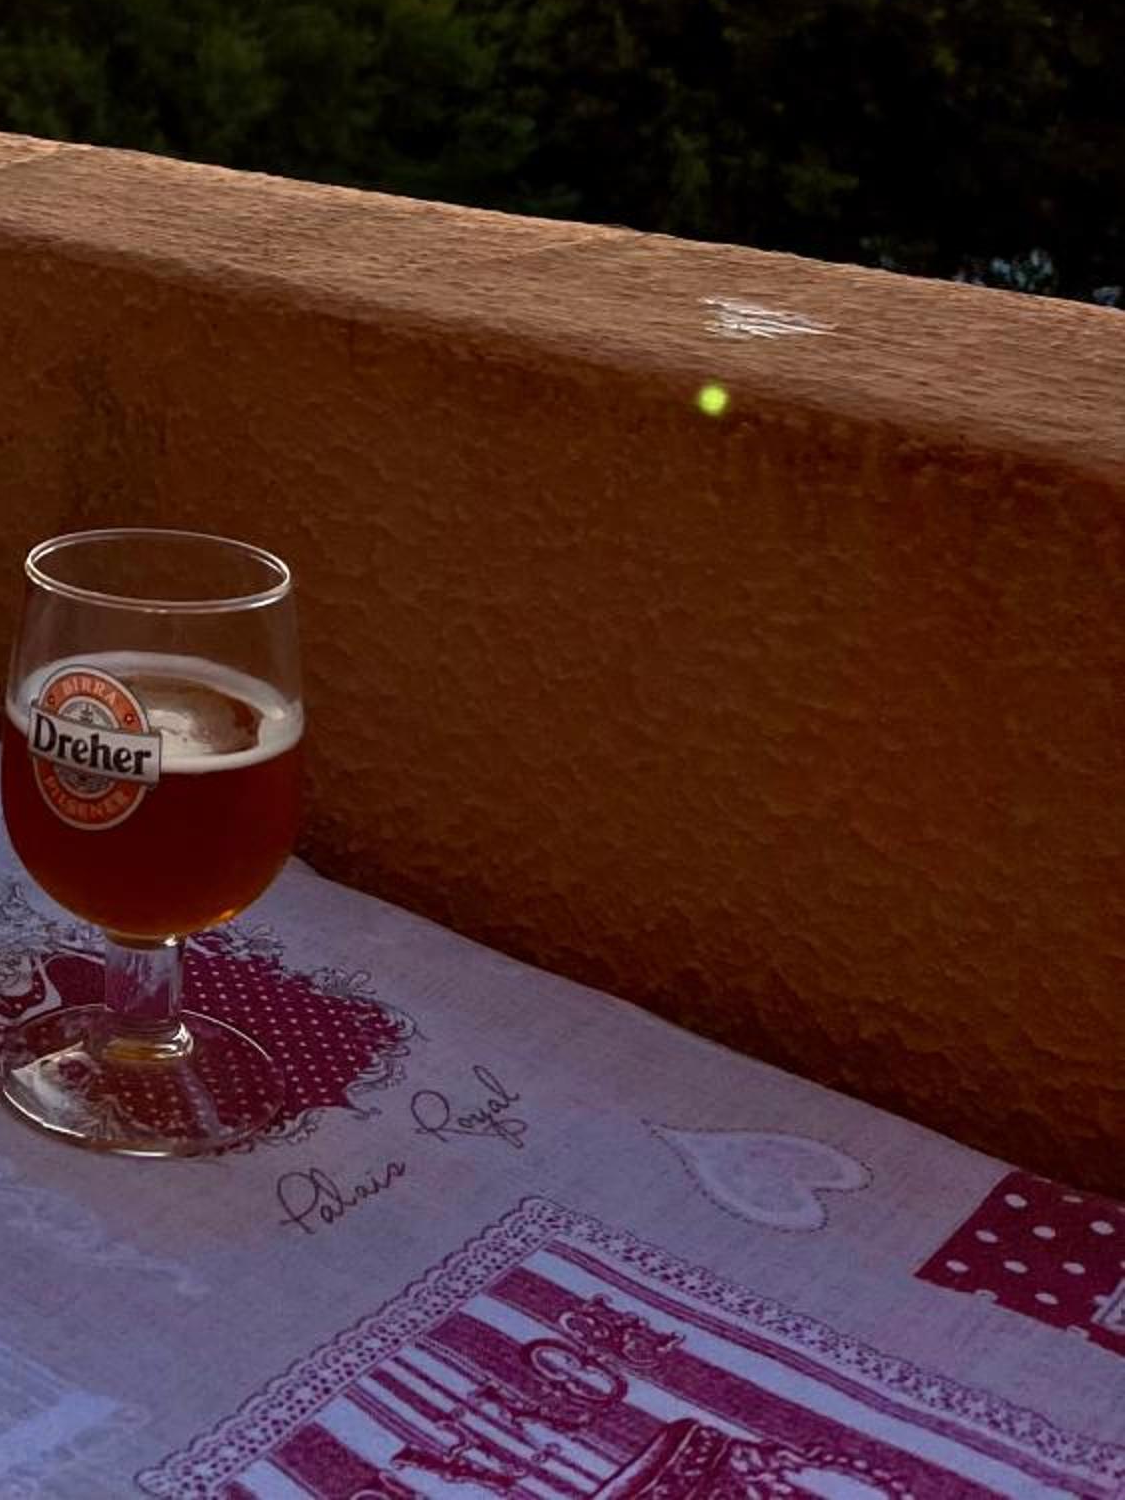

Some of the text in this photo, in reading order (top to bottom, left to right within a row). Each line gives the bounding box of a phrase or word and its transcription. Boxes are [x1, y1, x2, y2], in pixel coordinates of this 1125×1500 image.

[61, 674, 118, 704] BIRRA
[32, 713, 152, 776] Dreher
[277, 1064, 528, 1235] Palais Royal
